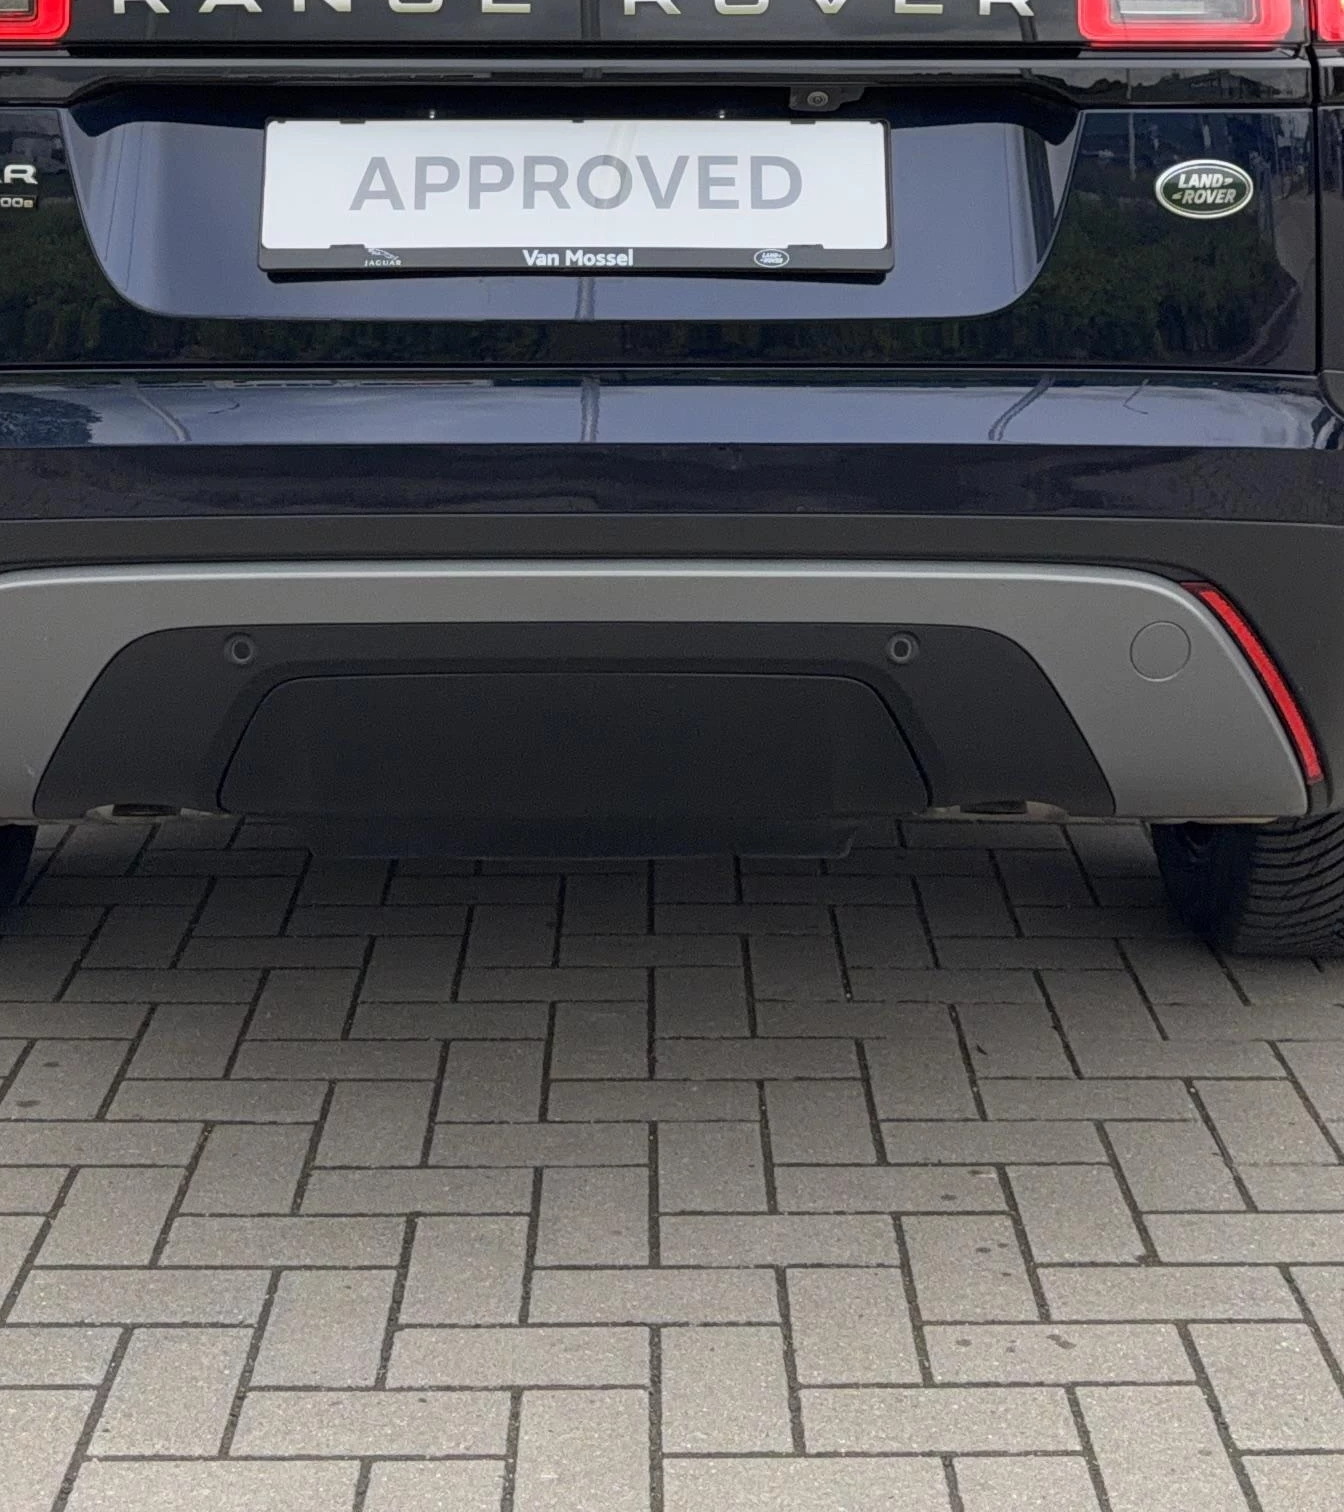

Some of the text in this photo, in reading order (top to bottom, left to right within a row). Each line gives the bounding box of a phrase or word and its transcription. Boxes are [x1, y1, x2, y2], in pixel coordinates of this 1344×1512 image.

[349, 154, 803, 211] APPROVED
[1178, 173, 1224, 189] LAND
[1181, 189, 1237, 204] ROVER
[364, 259, 402, 267] JAGUAR
[522, 248, 634, 266] Van Mossel
